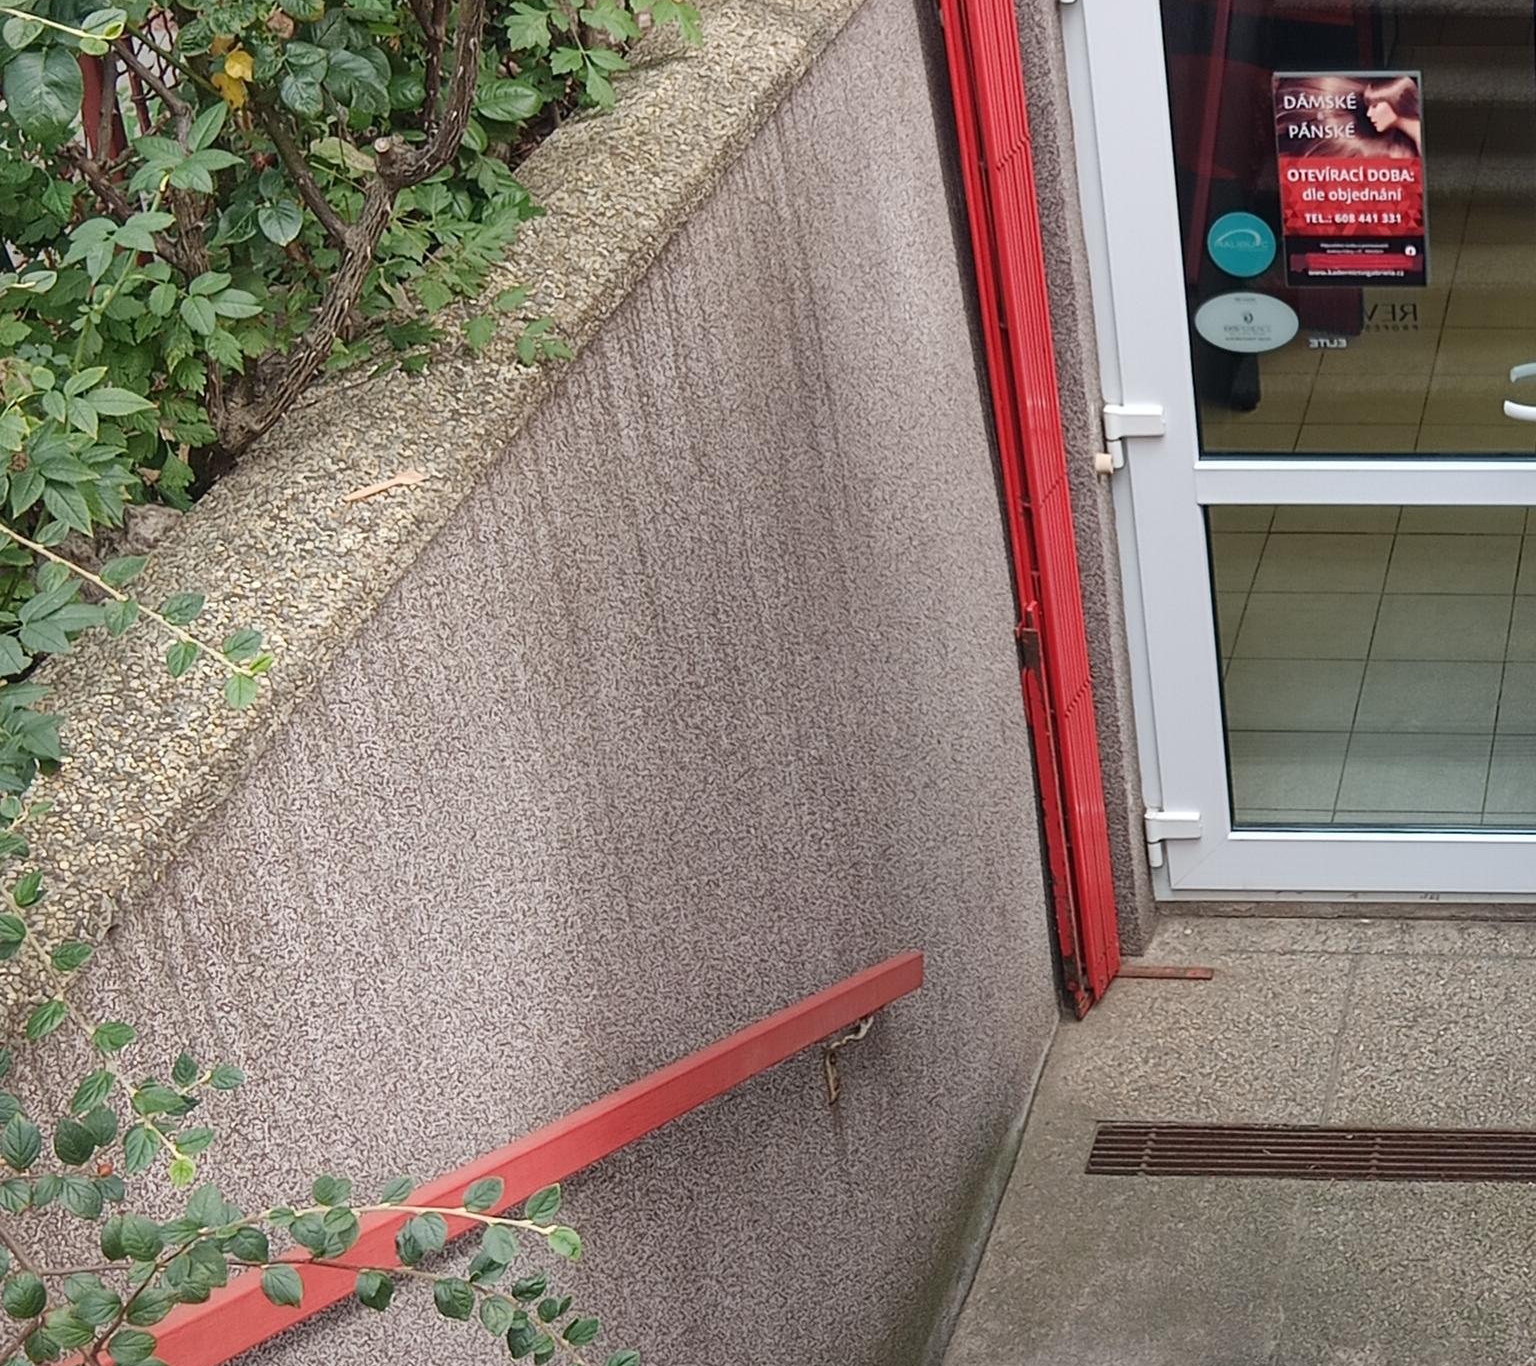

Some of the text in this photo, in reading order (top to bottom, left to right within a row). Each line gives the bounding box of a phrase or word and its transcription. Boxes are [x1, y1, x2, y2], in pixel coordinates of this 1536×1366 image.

[1283, 92, 1357, 110] DÁMSKÉ
[1288, 121, 1356, 139] PÁNSKÉ
[1287, 166, 1415, 182] OTEVÍRACÍ DOBA:
[1302, 187, 1402, 204] dle objednání
